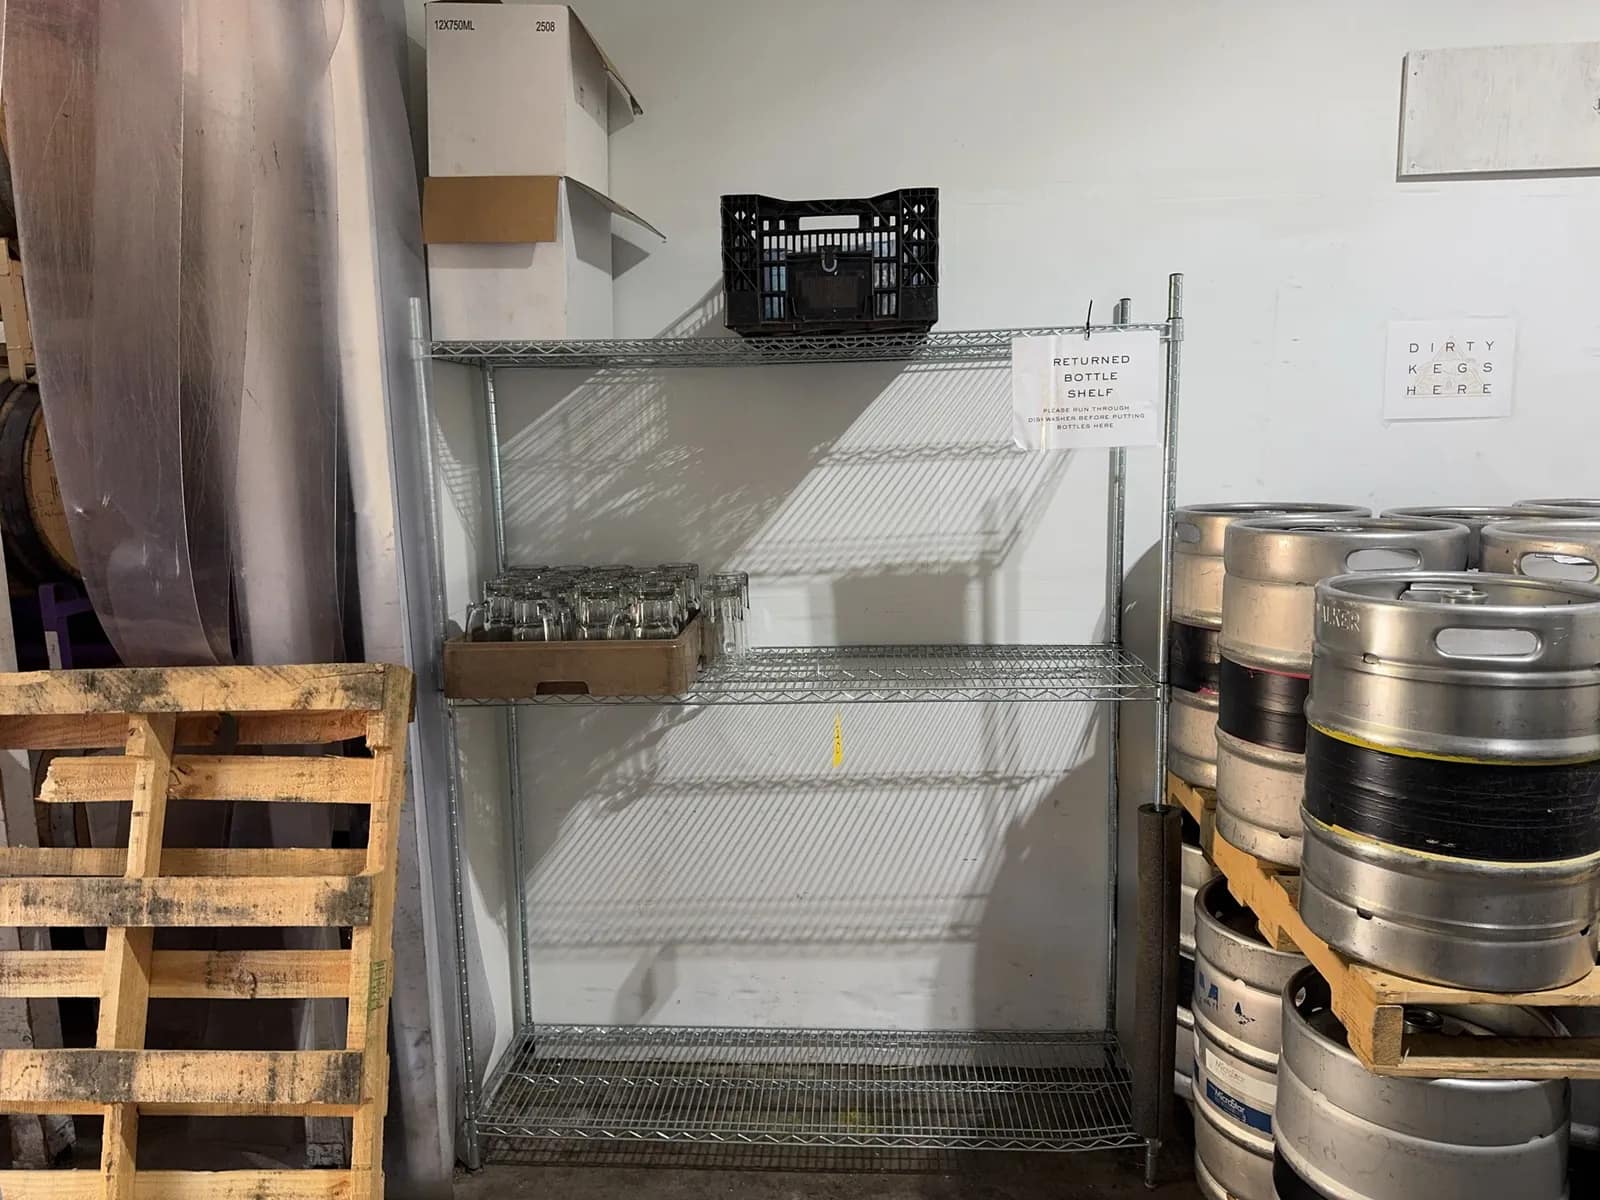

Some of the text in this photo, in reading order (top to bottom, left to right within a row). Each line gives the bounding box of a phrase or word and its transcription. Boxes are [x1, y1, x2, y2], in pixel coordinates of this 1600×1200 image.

[434, 20, 475, 31] 12X750ML
[536, 21, 556, 32] 2508
[1409, 341, 1494, 353] DIRTY
[1053, 355, 1130, 366] RETURNED
[1408, 362, 1493, 374] KEGS
[1064, 372, 1118, 382] BOTTLE
[1067, 388, 1114, 399] SHELF
[1406, 384, 1492, 396] HERE
